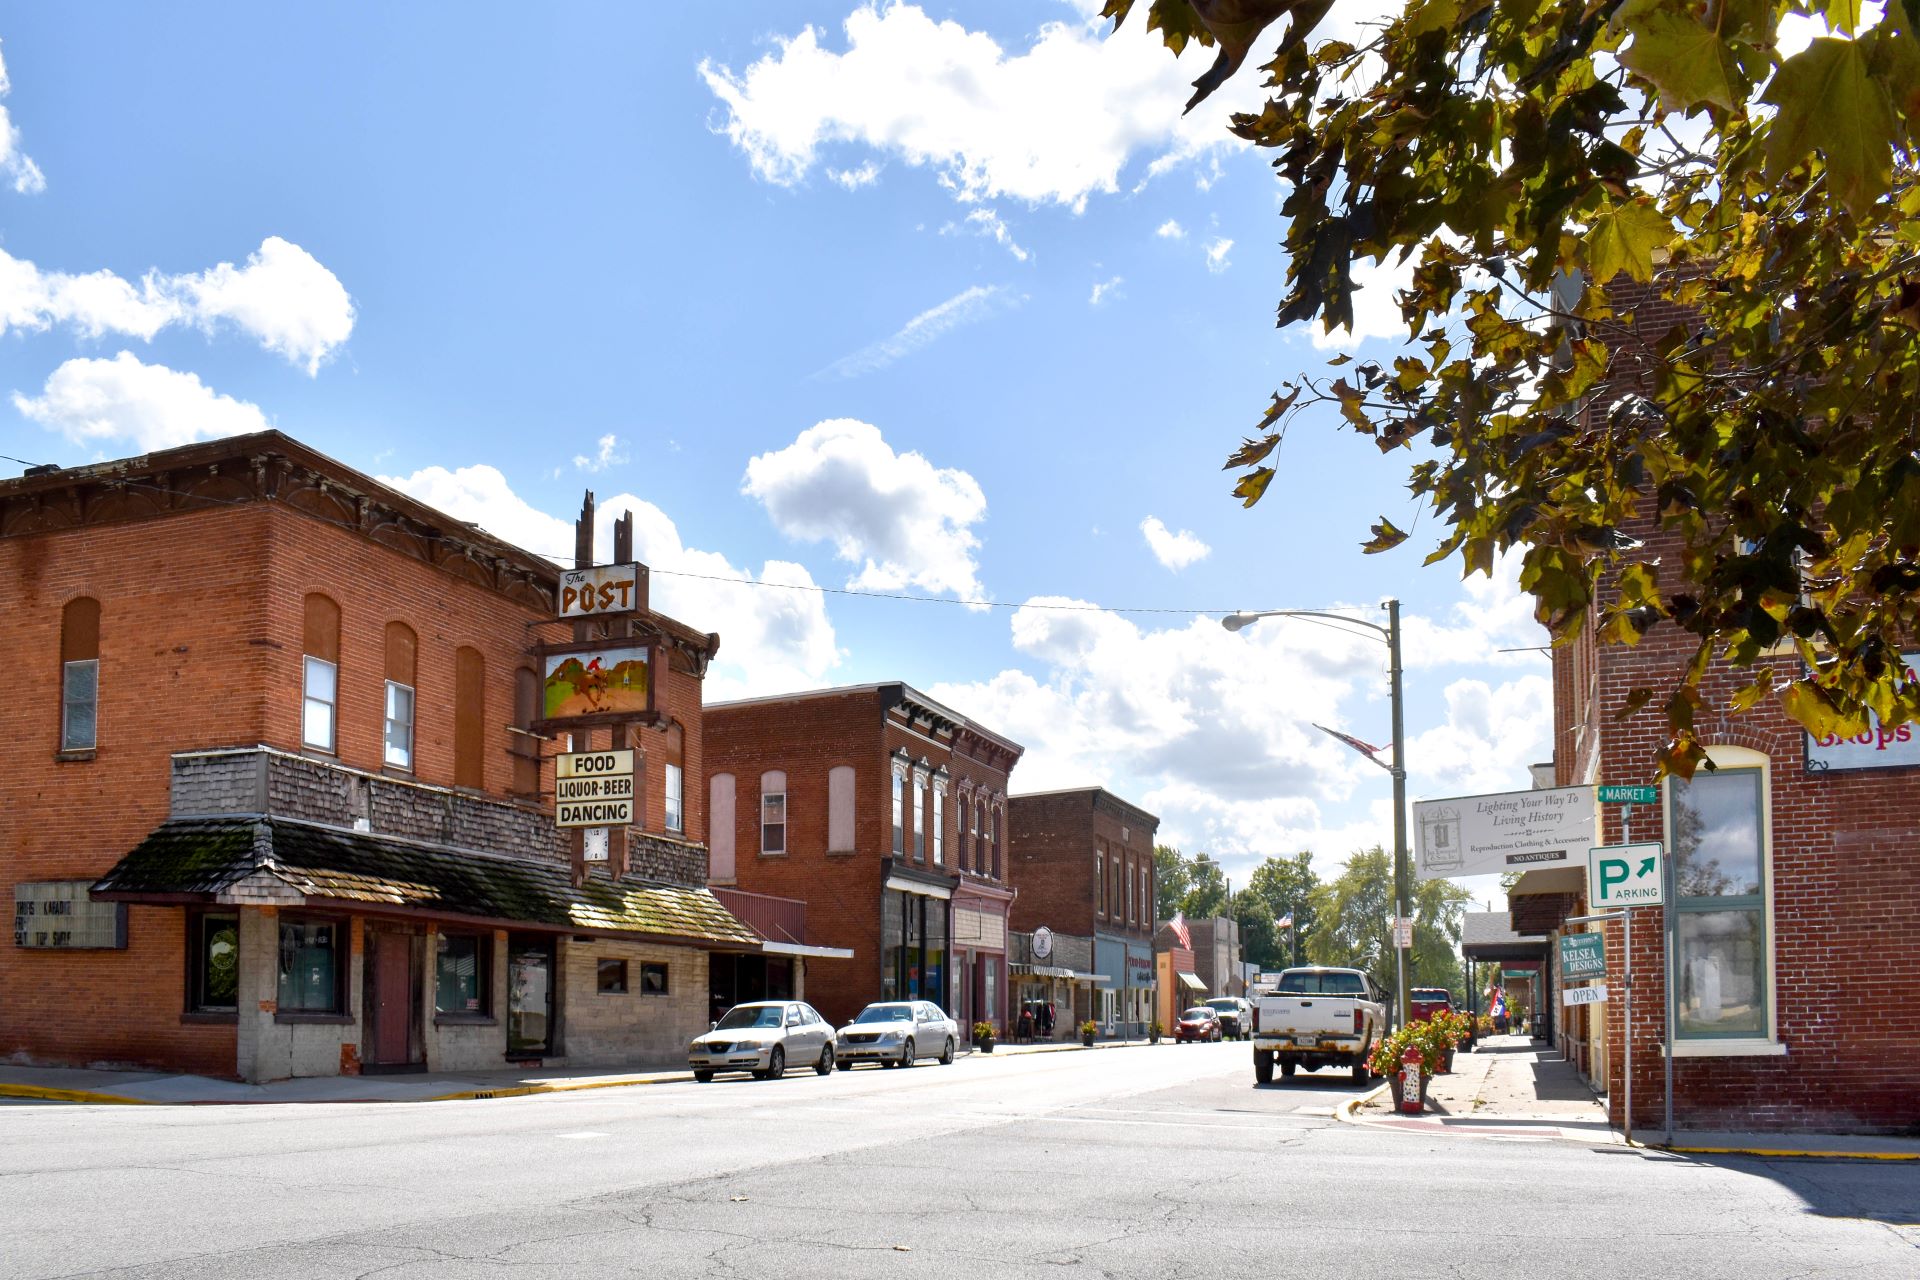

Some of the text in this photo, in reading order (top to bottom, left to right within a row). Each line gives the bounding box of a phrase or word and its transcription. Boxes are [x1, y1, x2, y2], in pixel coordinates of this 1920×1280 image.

[566, 571, 585, 585] The
[562, 580, 634, 613] POST
[1816, 724, 1912, 750] ops
[575, 755, 615, 773] FOOD
[558, 778, 632, 798] LIQUOR-BEER
[1606, 788, 1645, 800] MARKET
[1477, 792, 1579, 815] Lighting Your Way To
[561, 803, 628, 822] DANCING
[1493, 811, 1564, 827] Living History
[1470, 843, 1514, 854] Reproduction
[1514, 839, 1544, 848] Clothing
[1552, 835, 1590, 844] Accessories
[1525, 852, 1560, 861] ANTIQUES
[1562, 947, 1596, 963] KELSEA
[1569, 958, 1603, 972] DESIGNS
[1573, 988, 1599, 1003] OPEN
